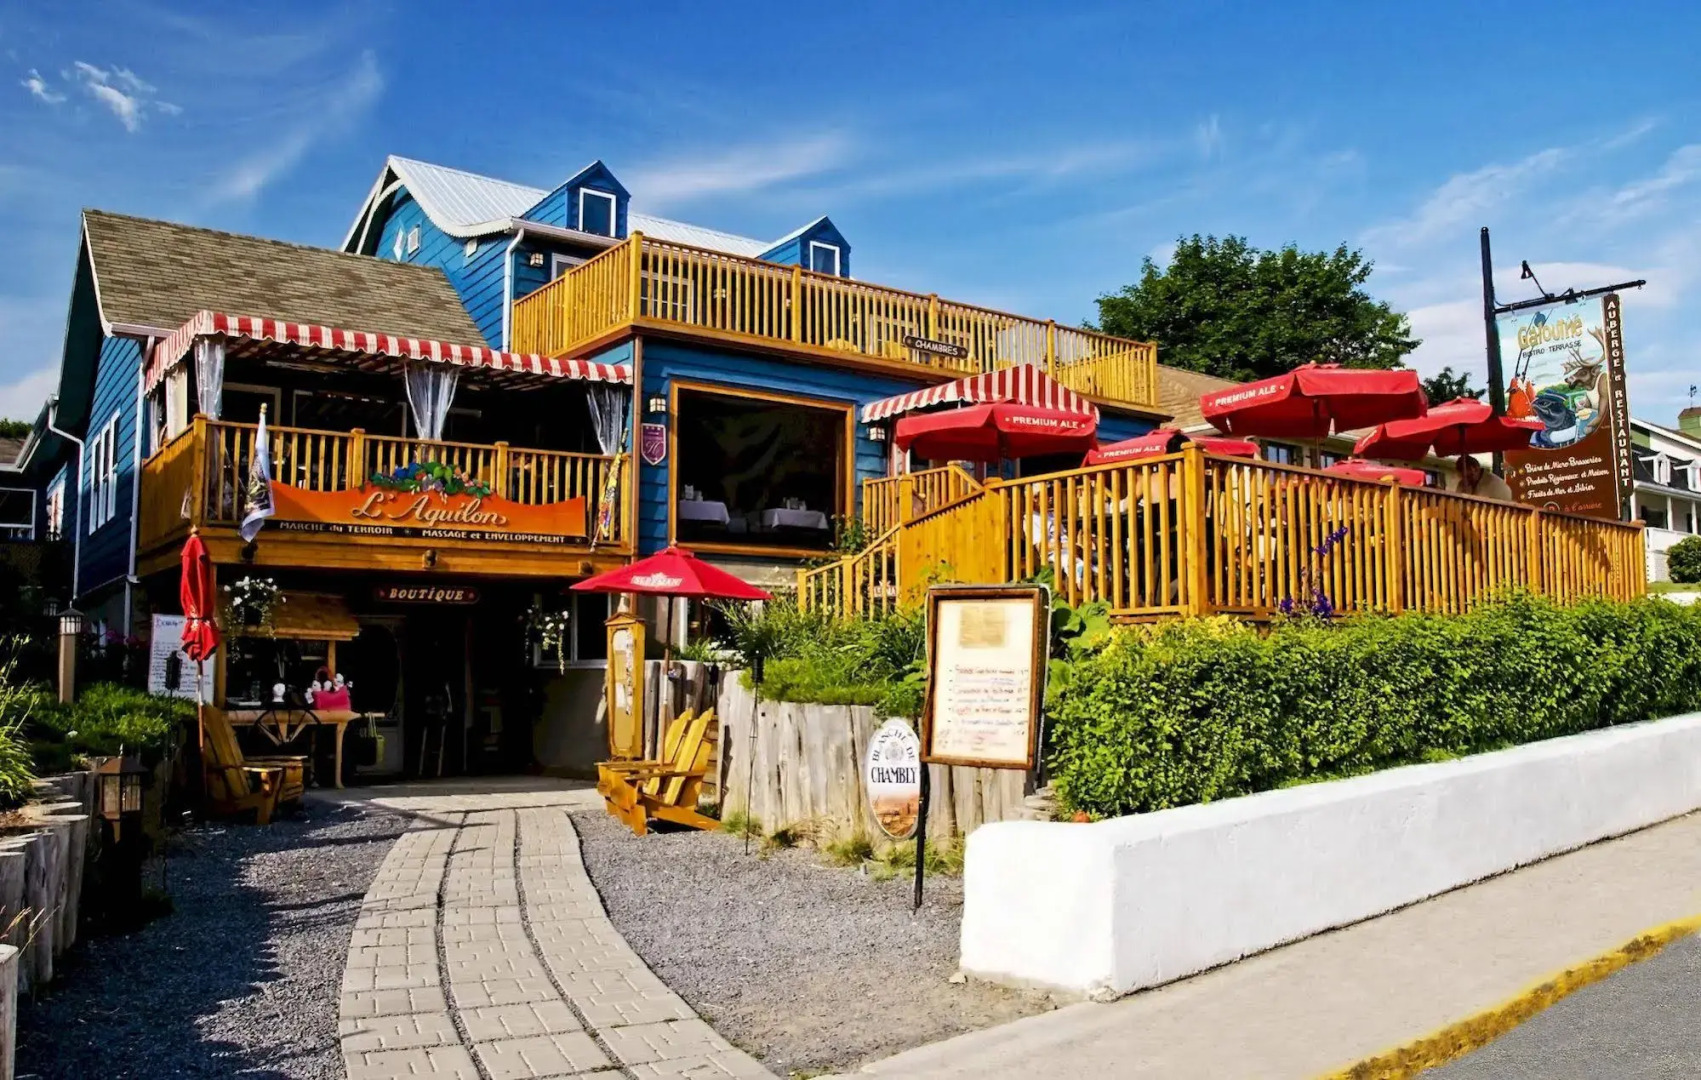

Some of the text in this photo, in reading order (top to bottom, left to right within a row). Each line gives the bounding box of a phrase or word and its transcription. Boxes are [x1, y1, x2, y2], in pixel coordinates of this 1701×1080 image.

[915, 340, 958, 356] CHAMBRES
[1522, 340, 1582, 358] BISTRO TERRASSE
[1215, 385, 1277, 407] PREMIUM ALE
[1607, 301, 1621, 367] AUBERGE
[1614, 390, 1629, 486] RESTAURANT
[1012, 416, 1079, 429] PREMIUM ALE
[1103, 447, 1142, 458] PREMIUM
[1543, 462, 1551, 470] de
[1587, 468, 1609, 477] Maison
[1527, 489, 1546, 499] Fruits
[1546, 488, 1553, 496] de
[1553, 487, 1566, 495] Mer
[329, 524, 343, 533] du
[347, 525, 393, 535] TERROIR
[422, 529, 467, 539] MASSAGE
[470, 531, 480, 540] et
[485, 532, 565, 544] ENVELOPPEMENT
[871, 767, 917, 784] CHAMBLY
